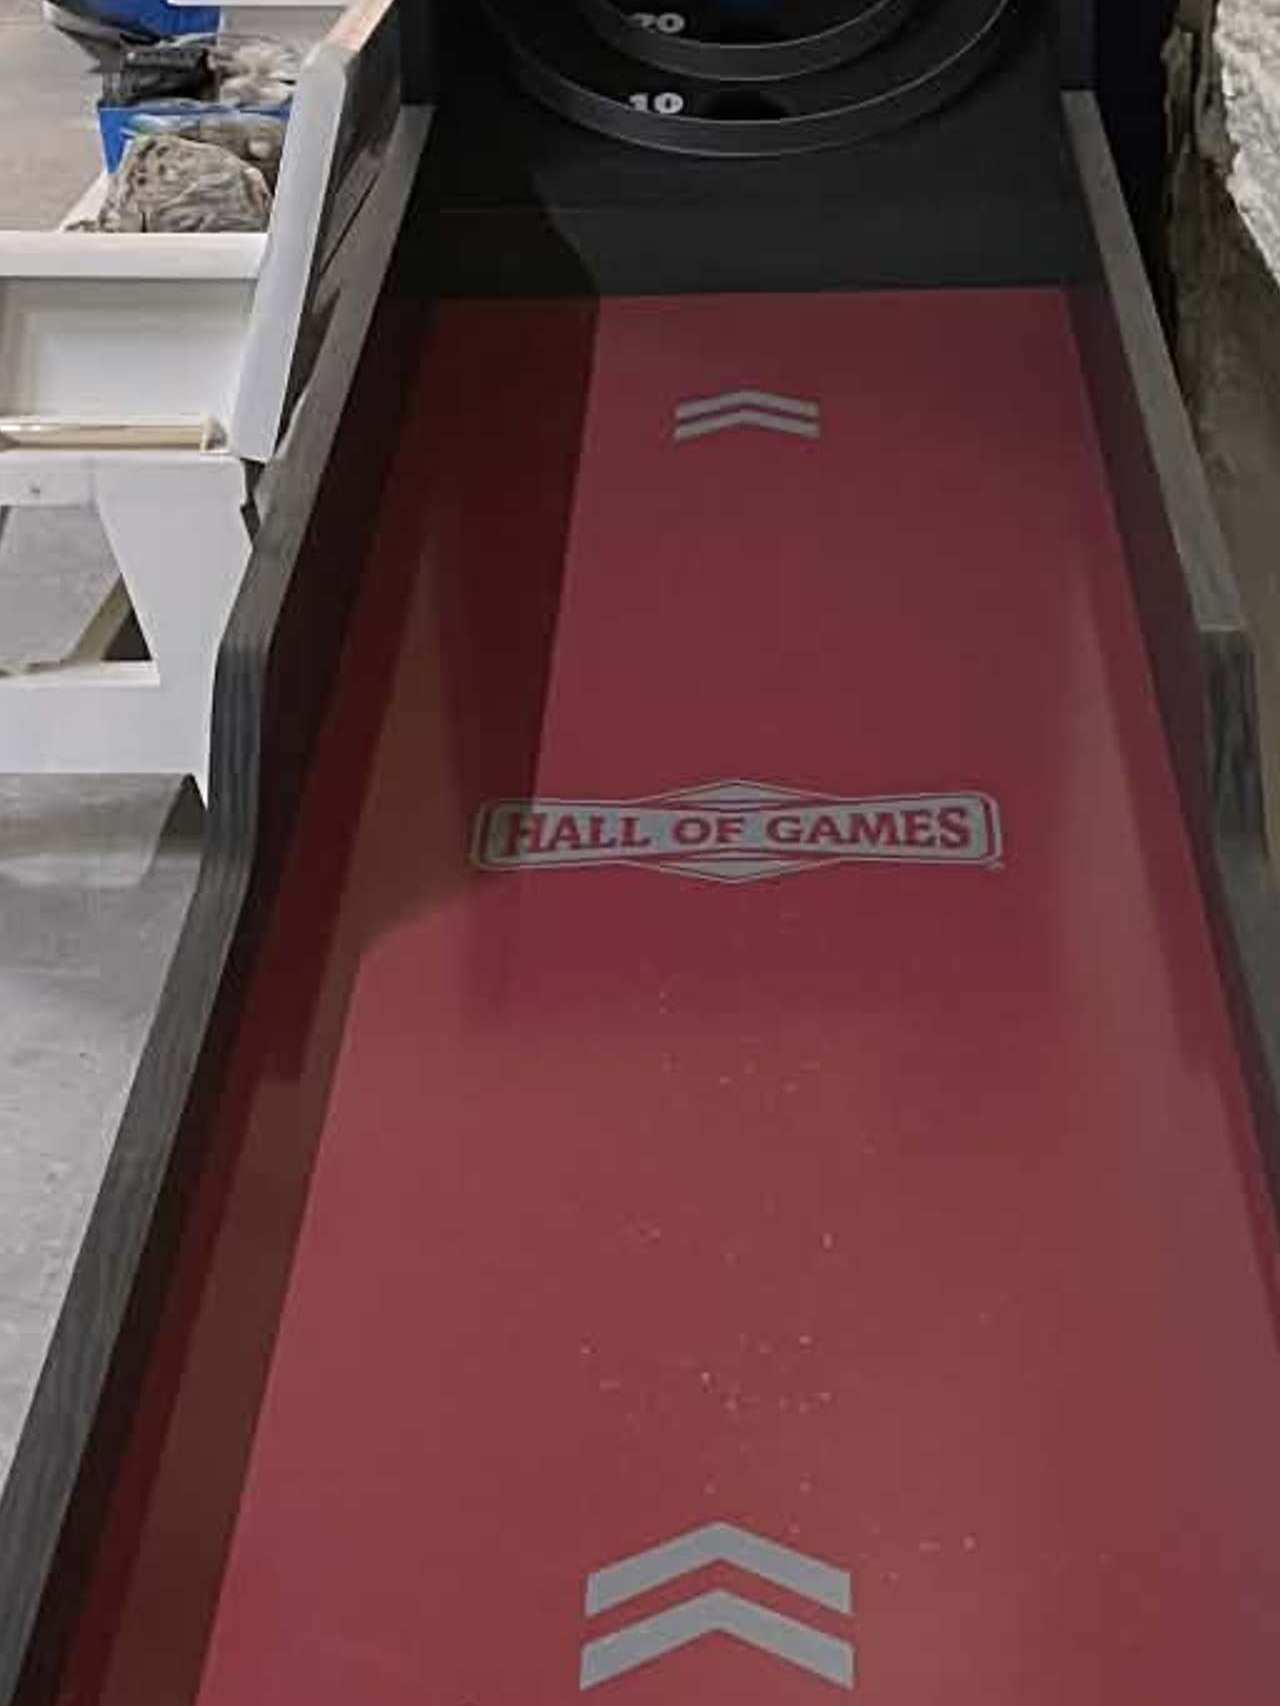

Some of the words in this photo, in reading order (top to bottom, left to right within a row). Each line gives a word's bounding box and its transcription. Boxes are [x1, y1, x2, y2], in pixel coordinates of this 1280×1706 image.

[629, 93, 686, 116] 10
[506, 812, 651, 856] HALL
[671, 814, 743, 846] OF
[765, 806, 972, 850] GAMES
